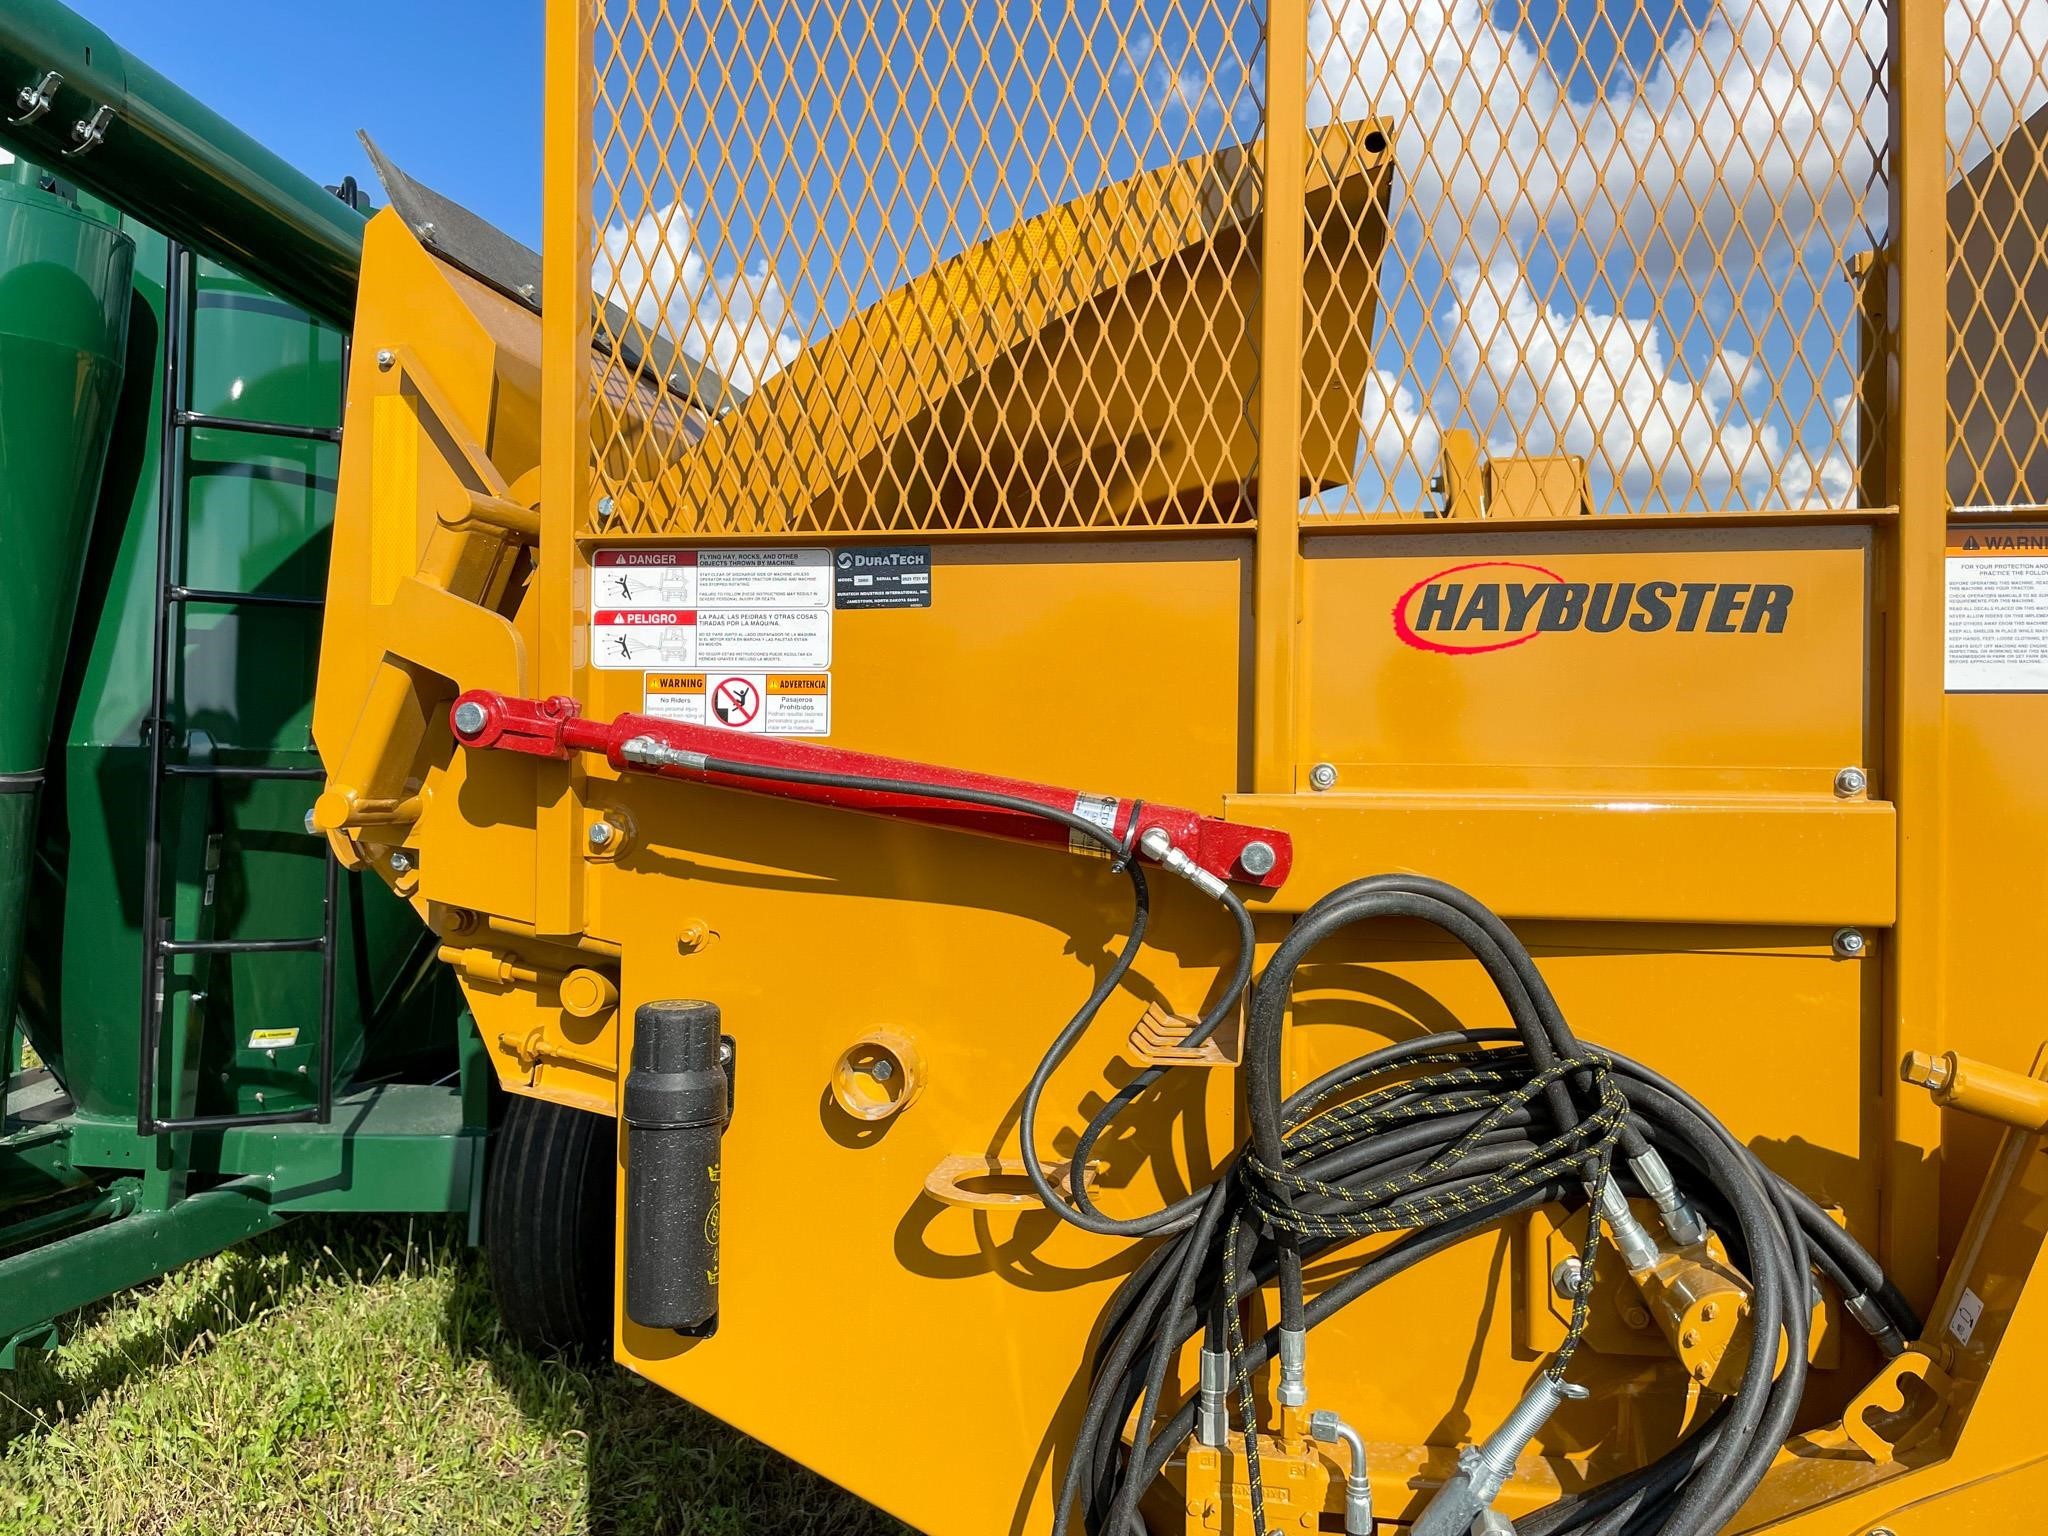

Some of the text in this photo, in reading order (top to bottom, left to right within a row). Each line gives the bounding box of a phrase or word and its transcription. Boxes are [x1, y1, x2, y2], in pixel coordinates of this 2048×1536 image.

[629, 555, 676, 564] DANGER
[1415, 582, 1794, 633] HAYBUSTER
[627, 613, 677, 623] PELIGRO
[660, 678, 702, 688] WARNING
[780, 680, 825, 689] ADVERTENCIA
